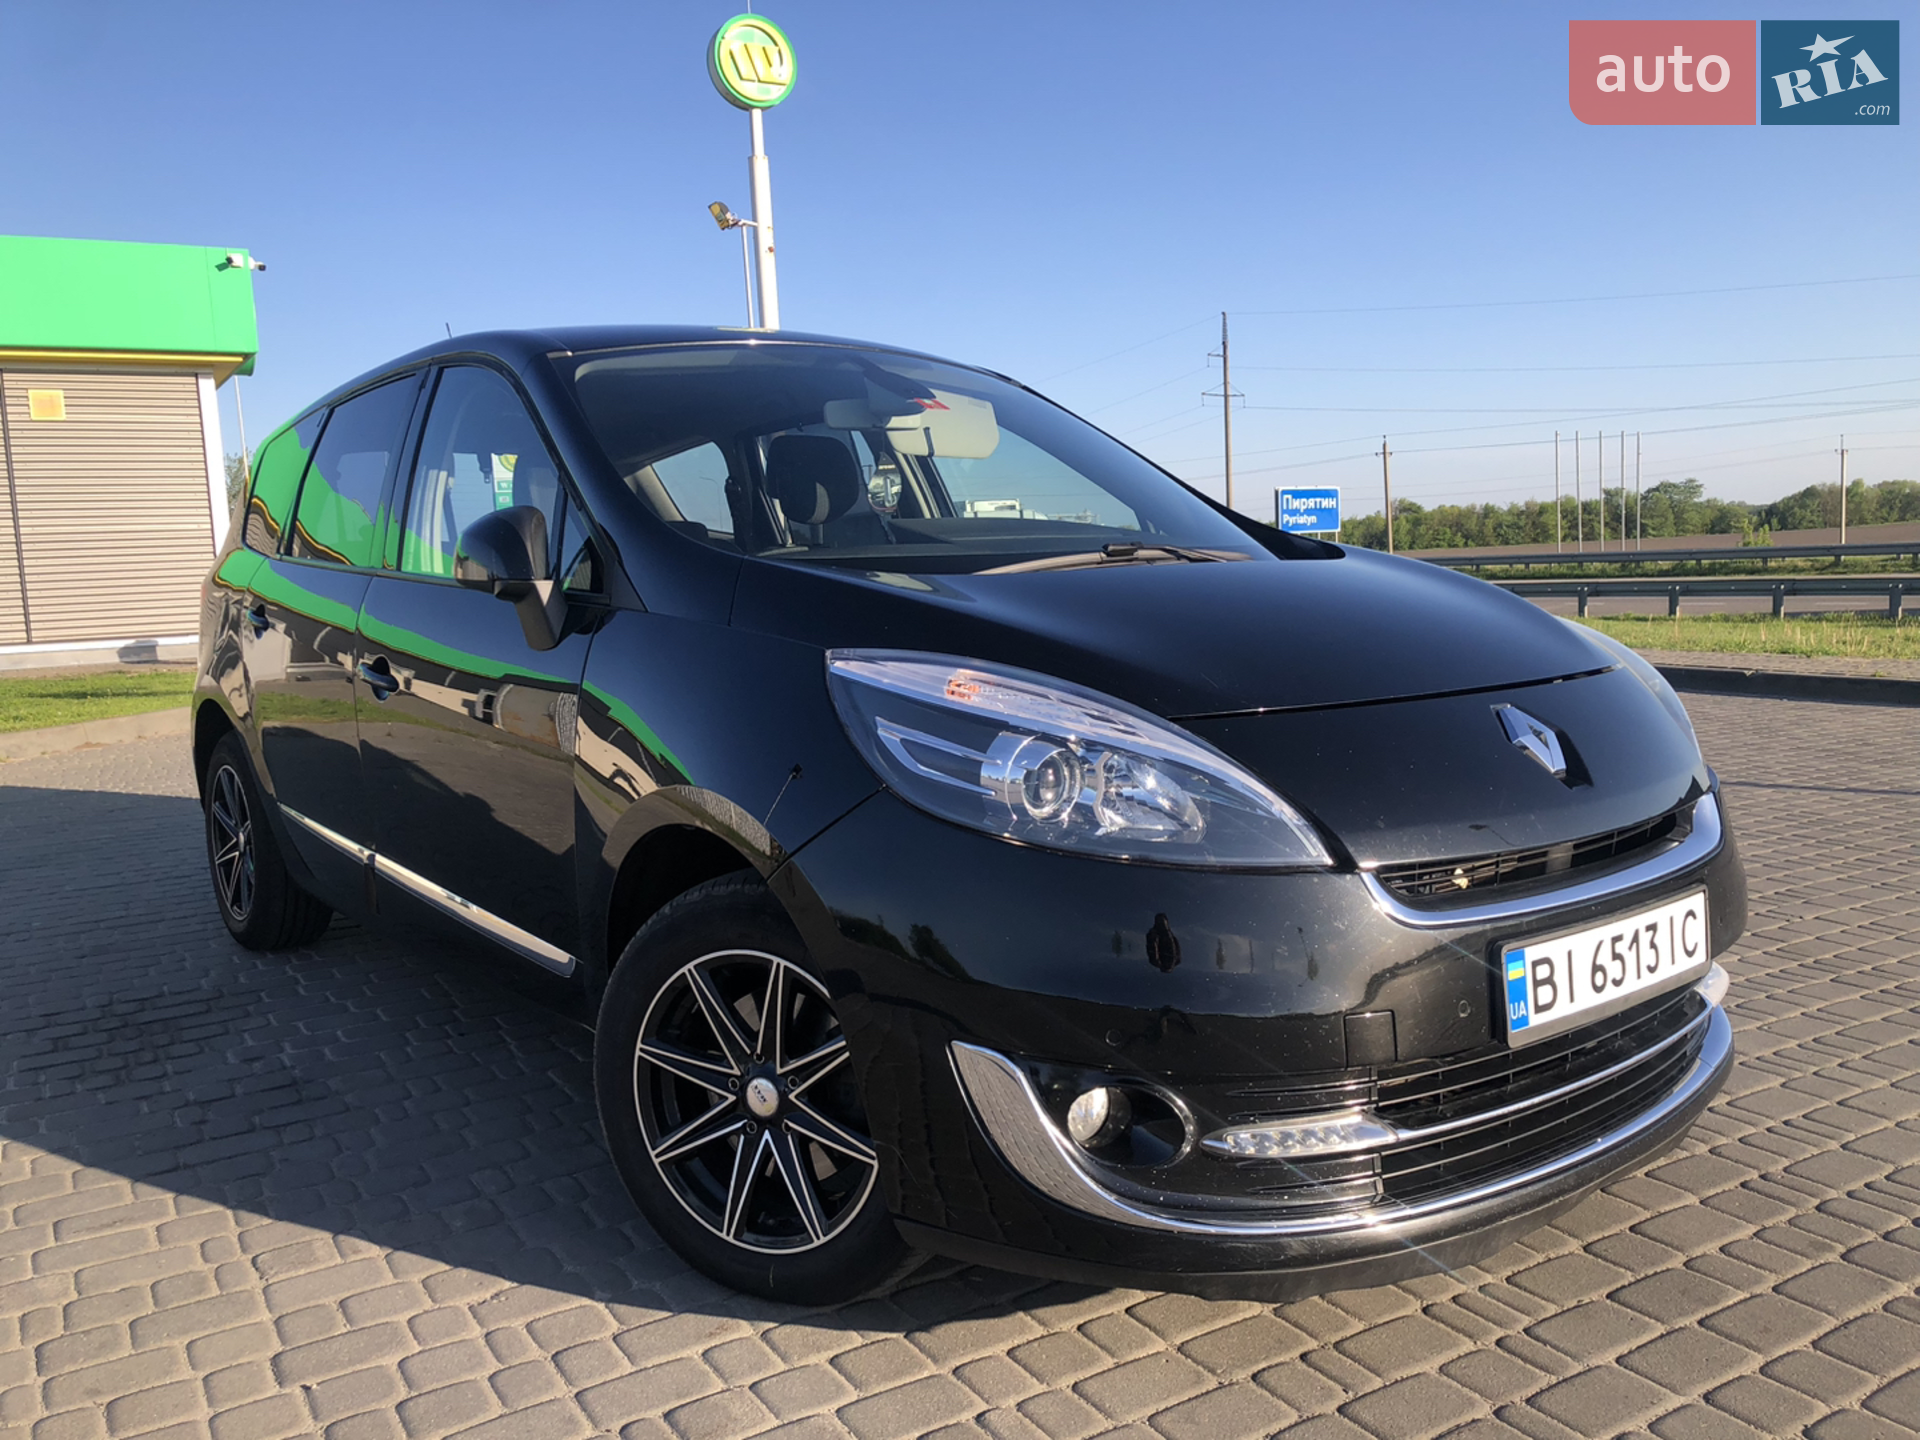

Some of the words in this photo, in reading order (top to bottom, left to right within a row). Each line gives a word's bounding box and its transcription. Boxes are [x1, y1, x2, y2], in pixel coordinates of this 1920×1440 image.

[1283, 494, 1337, 513] Пирятин
[1283, 513, 1317, 527] Pyriatyn
[1531, 949, 1575, 1015] BI
[1590, 921, 1660, 994] 6513
[1670, 909, 1699, 966] IC
[1510, 1000, 1527, 1020] UA
